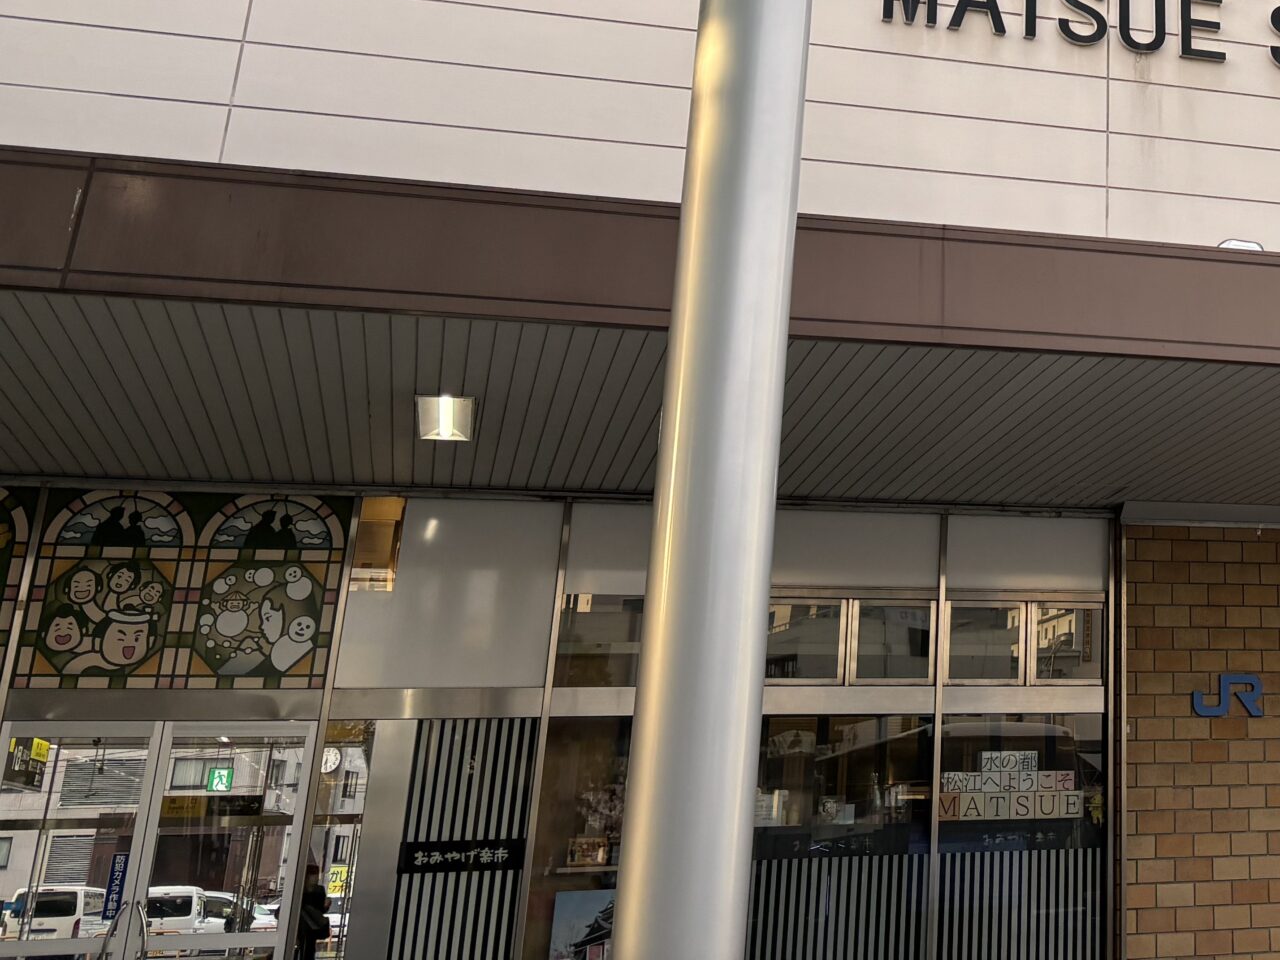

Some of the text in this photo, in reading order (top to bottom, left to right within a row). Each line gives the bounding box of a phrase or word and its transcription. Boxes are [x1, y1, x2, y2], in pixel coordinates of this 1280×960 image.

[1192, 673, 1264, 717] JR
[983, 751, 1037, 771] 水の都
[944, 772, 1073, 792] 松江へようこそ
[938, 794, 1080, 817] MATSUE
[414, 847, 509, 866] おみやげ楽市
